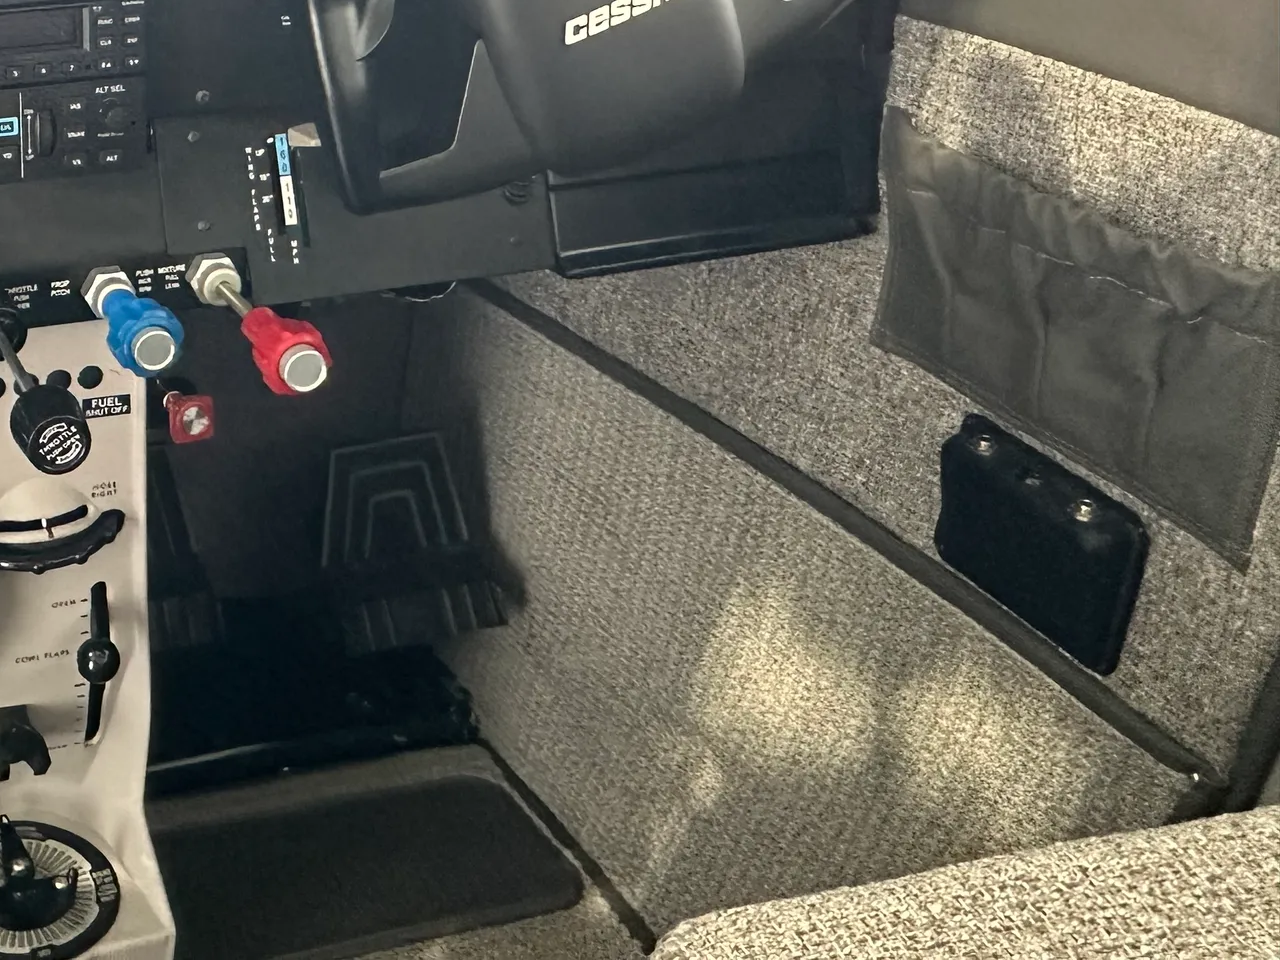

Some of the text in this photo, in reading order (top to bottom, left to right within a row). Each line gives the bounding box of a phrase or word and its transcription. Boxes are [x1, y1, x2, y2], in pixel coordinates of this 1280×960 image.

[95, 84, 126, 94] ALT SEL
[91, 396, 123, 409] FUEL
[85, 405, 128, 418] SHUT OFF
[38, 425, 78, 456] THROTTLE
[51, 598, 77, 609] OPEN
[43, 648, 70, 659] FLAPS
